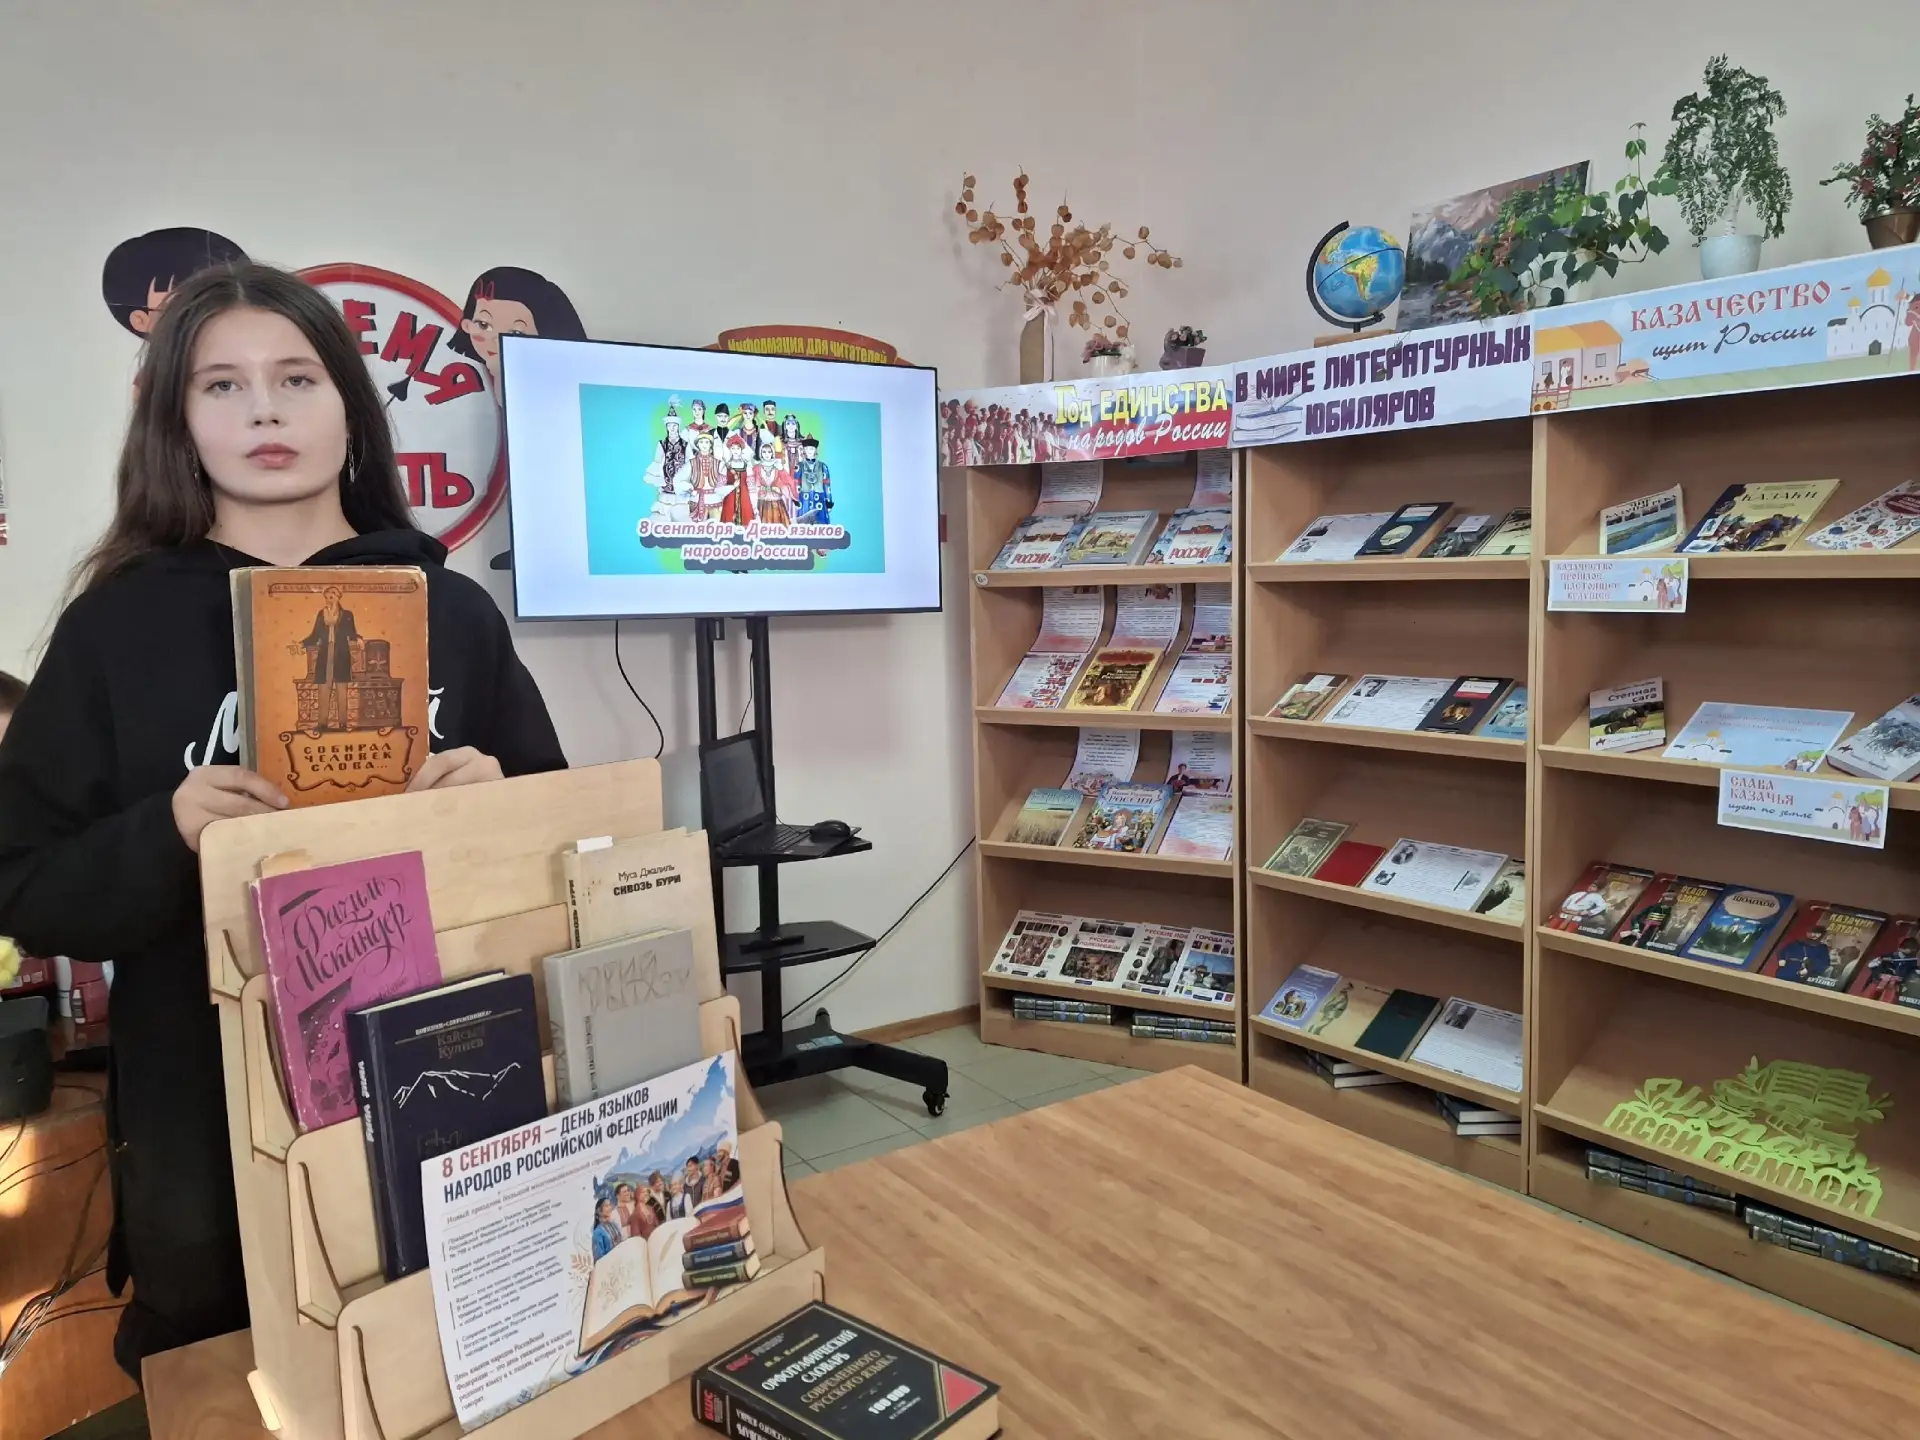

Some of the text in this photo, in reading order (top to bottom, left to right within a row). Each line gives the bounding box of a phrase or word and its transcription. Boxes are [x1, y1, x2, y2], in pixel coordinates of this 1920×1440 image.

[1631, 280, 1831, 332] КАЗАЧЕСТВО
[342, 299, 485, 405] ЕМЯ
[1652, 322, 1816, 360] щит России
[1235, 325, 1531, 403] В МИРЕ ЛИТЕРАТУРНЫХ
[1100, 380, 1228, 426] ЕДИНСТВА
[1305, 387, 1435, 435] ЮБИЛЯРОВ
[1067, 413, 1228, 456] народов России
[639, 522, 648, 535] 8
[654, 522, 733, 538] сентября
[747, 522, 786, 538] День
[790, 525, 842, 537] языков
[683, 544, 807, 561] народов России
[1608, 687, 1657, 702] Степная
[1632, 693, 1657, 703] сага
[304, 742, 392, 755] СОБИРАЛ
[304, 752, 392, 764] ЧЕЛОВЕК
[311, 760, 388, 772] СЛОВА...
[1730, 775, 1775, 791] СЛАВА
[1730, 788, 1794, 806] КАЗАЧЬЯ
[1778, 809, 1813, 820] земле
[613, 874, 682, 897] СКВОЗЬ БУРИ
[618, 864, 675, 882] Муса Джалиль
[1733, 895, 1776, 909] ШОЛОХОВ
[296, 901, 414, 992] Искандер
[440, 1157, 454, 1179] 8
[458, 1124, 542, 1172] СЕНТЯБРЯ
[557, 1105, 594, 1135] ДЕНЬ
[596, 1085, 650, 1120] ЯЗЫКОВ
[442, 1160, 512, 1204] НАРОДОВ
[514, 1123, 603, 1176] РОССИЙСКОЙ
[605, 1097, 679, 1141] ФЕДЕРАЦИИ
[762, 1329, 858, 1391] ОРФОГРАФИЧЕСКИЙ
[801, 1352, 851, 1384] СЛОВАРЬ
[801, 1350, 881, 1403] СОВРЕМЕННОГО
[809, 1375, 864, 1412] РУССКОГО
[861, 1354, 898, 1380] ЯЗЫКА
